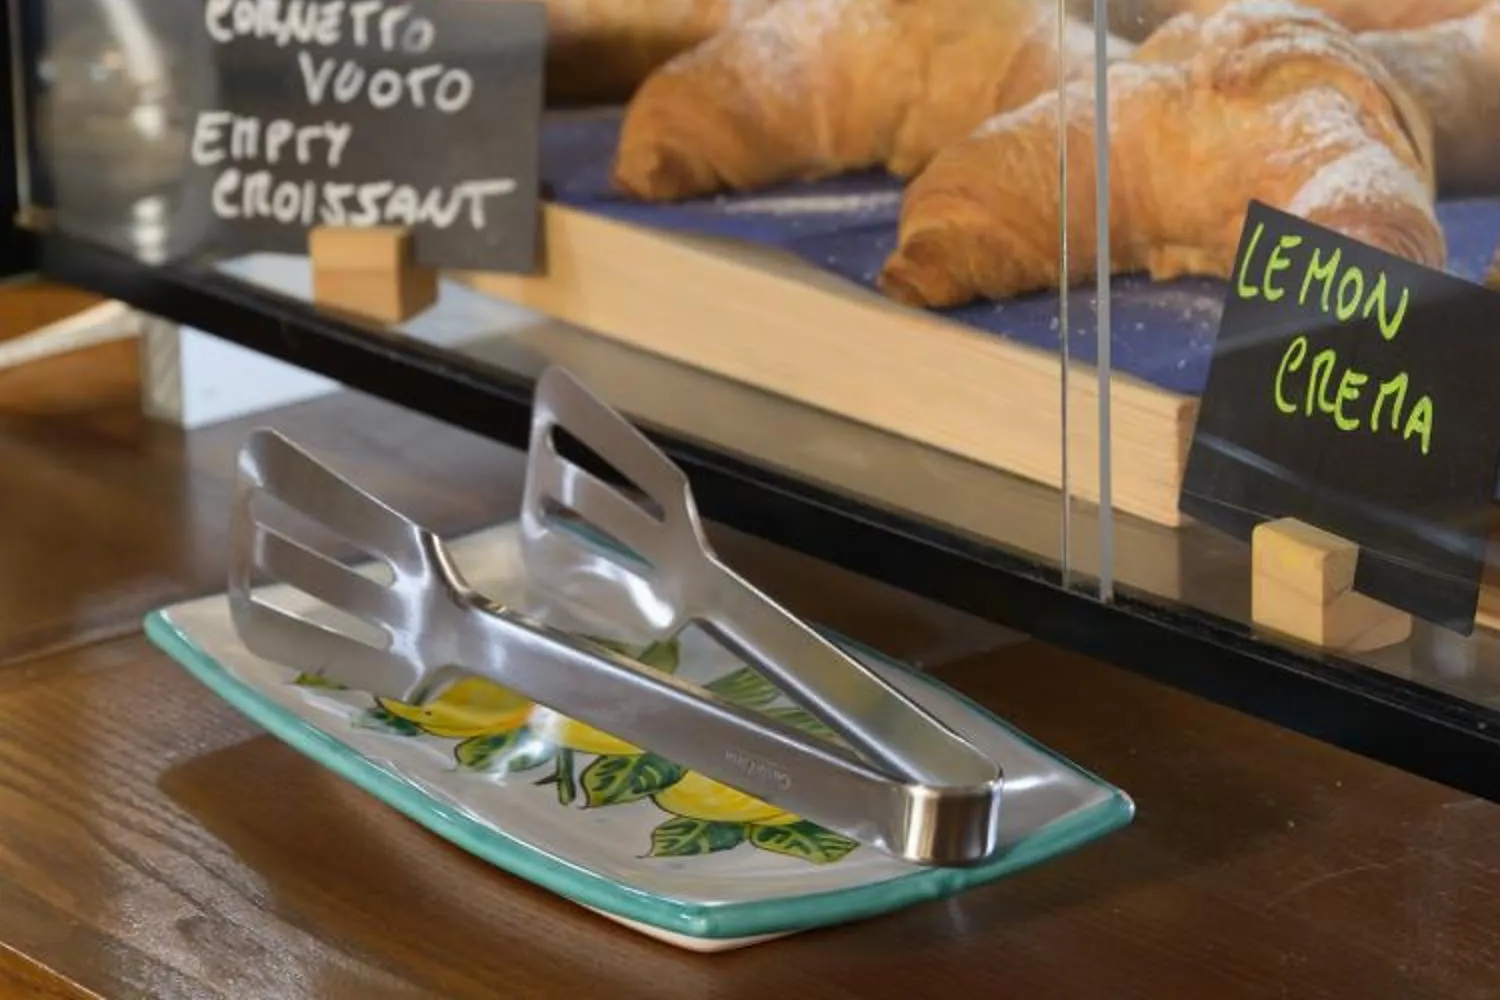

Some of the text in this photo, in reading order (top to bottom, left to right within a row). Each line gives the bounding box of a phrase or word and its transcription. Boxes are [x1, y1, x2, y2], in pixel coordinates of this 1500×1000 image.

[299, 51, 473, 112] VUOTO
[192, 111, 352, 167] EMPTY
[212, 168, 517, 229] CROISSANT
[1238, 222, 1408, 340] LEMON
[1275, 336, 1433, 454] CREMA
